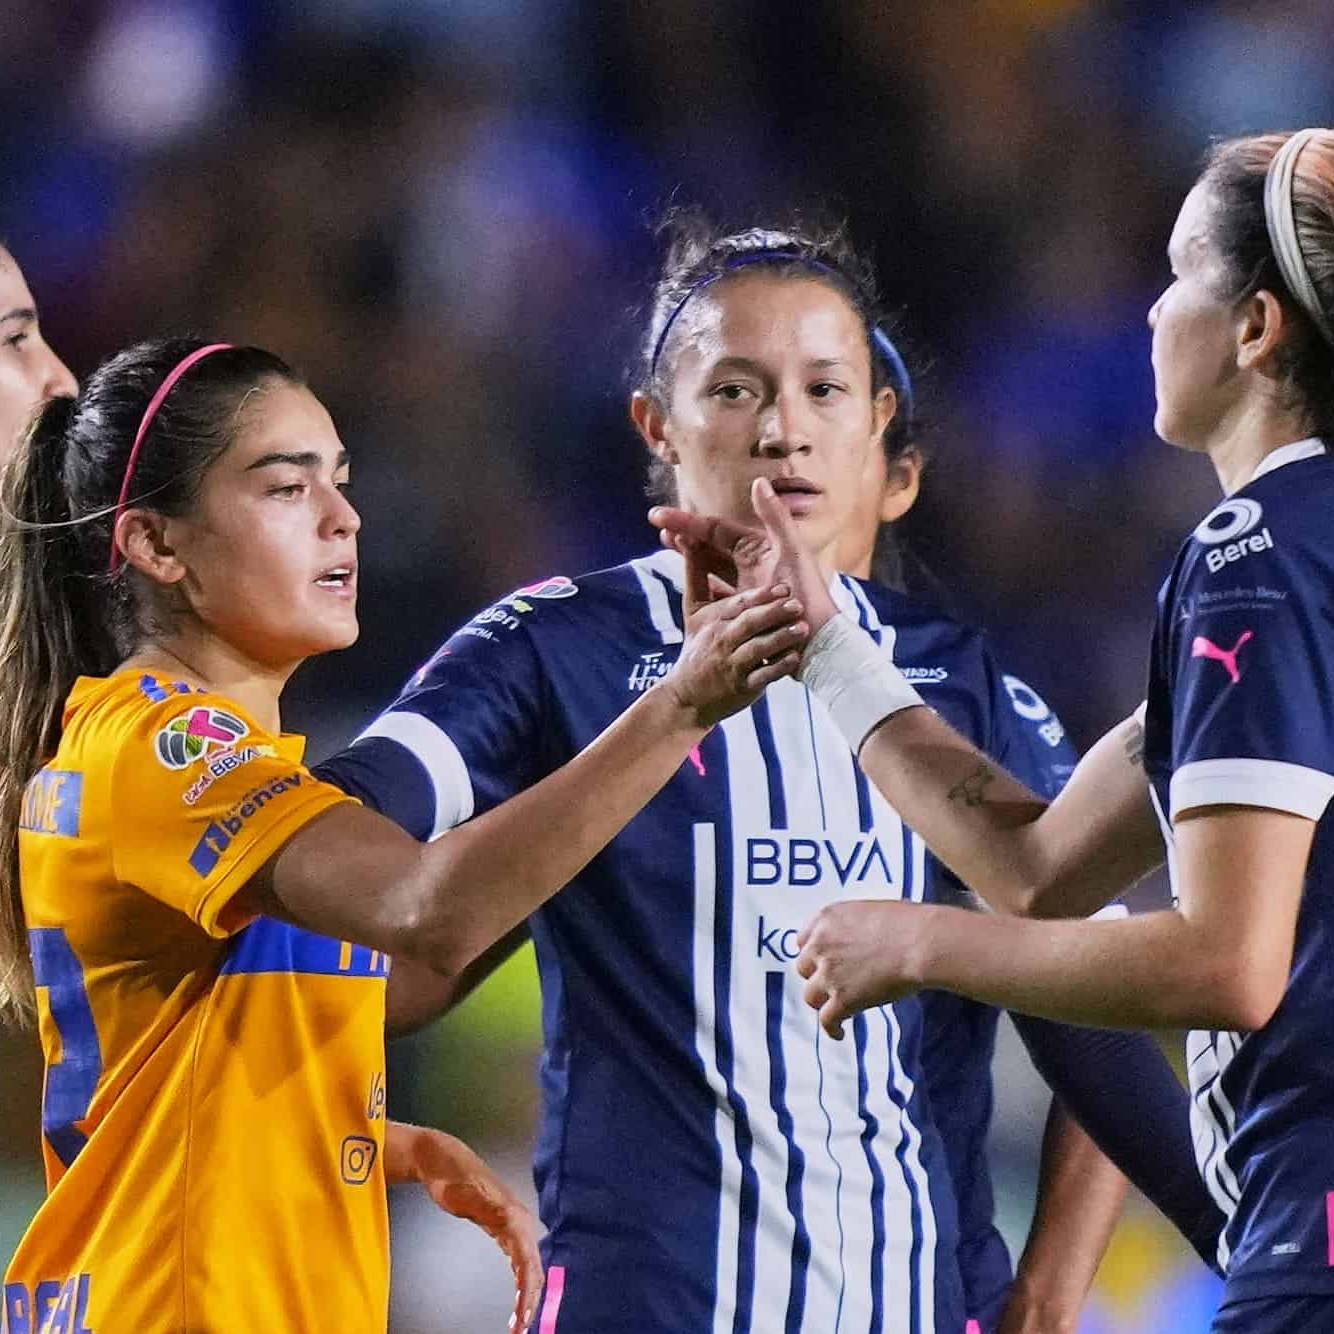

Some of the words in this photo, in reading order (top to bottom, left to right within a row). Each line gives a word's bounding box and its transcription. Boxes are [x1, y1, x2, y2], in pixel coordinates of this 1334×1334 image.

[1205, 527, 1273, 573] Berel
[209, 747, 260, 779] BBVA
[746, 836, 893, 887] BBVA
[756, 914, 802, 963] ko
